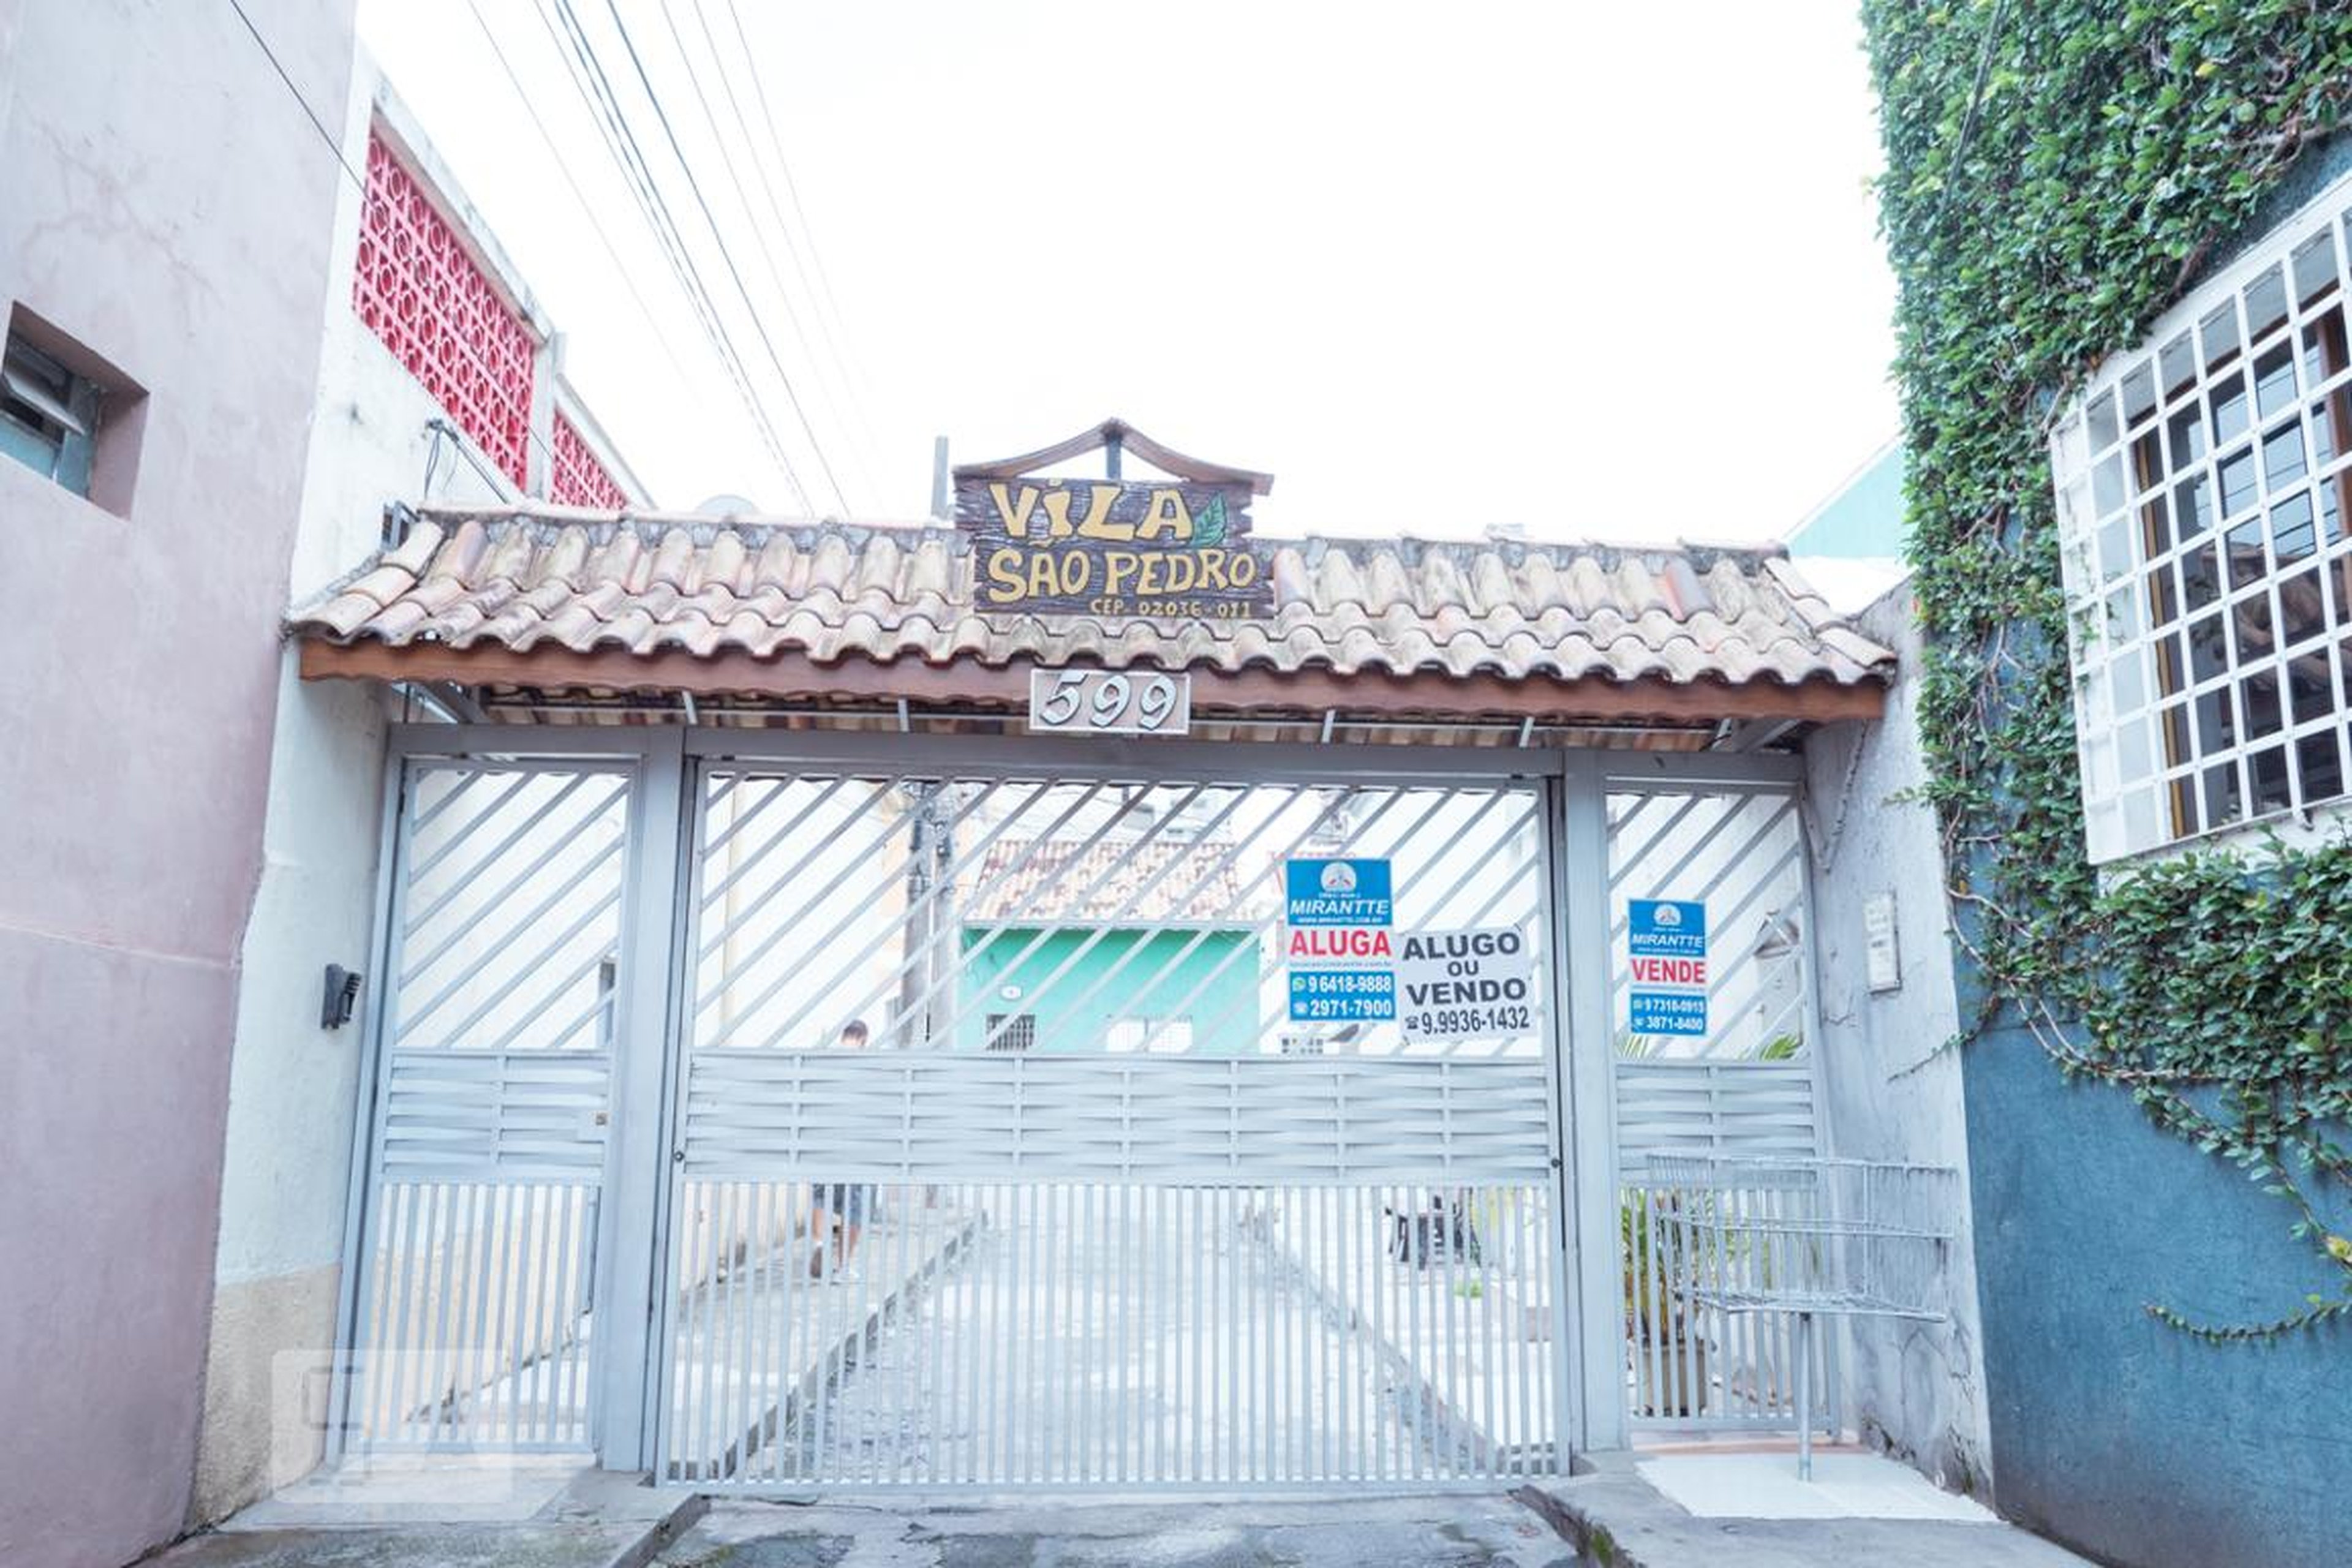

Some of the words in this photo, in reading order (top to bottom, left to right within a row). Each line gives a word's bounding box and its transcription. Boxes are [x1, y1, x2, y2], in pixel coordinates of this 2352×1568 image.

[1104, 549, 1256, 595] PEDRO
[1041, 673, 1177, 730] 599
[1290, 899, 1389, 914] MIRANTTE
[1290, 930, 1392, 957] ALUGA
[1403, 932, 1520, 960] ALUGO
[1632, 933, 1703, 948] MIRANTTE
[1448, 960, 1479, 978] OU
[1631, 958, 1706, 983] VENDE
[1406, 978, 1526, 1006] VENDO
[1310, 999, 1392, 1016] 2971-7900
[1422, 1006, 1530, 1035] 9.9936-1432
